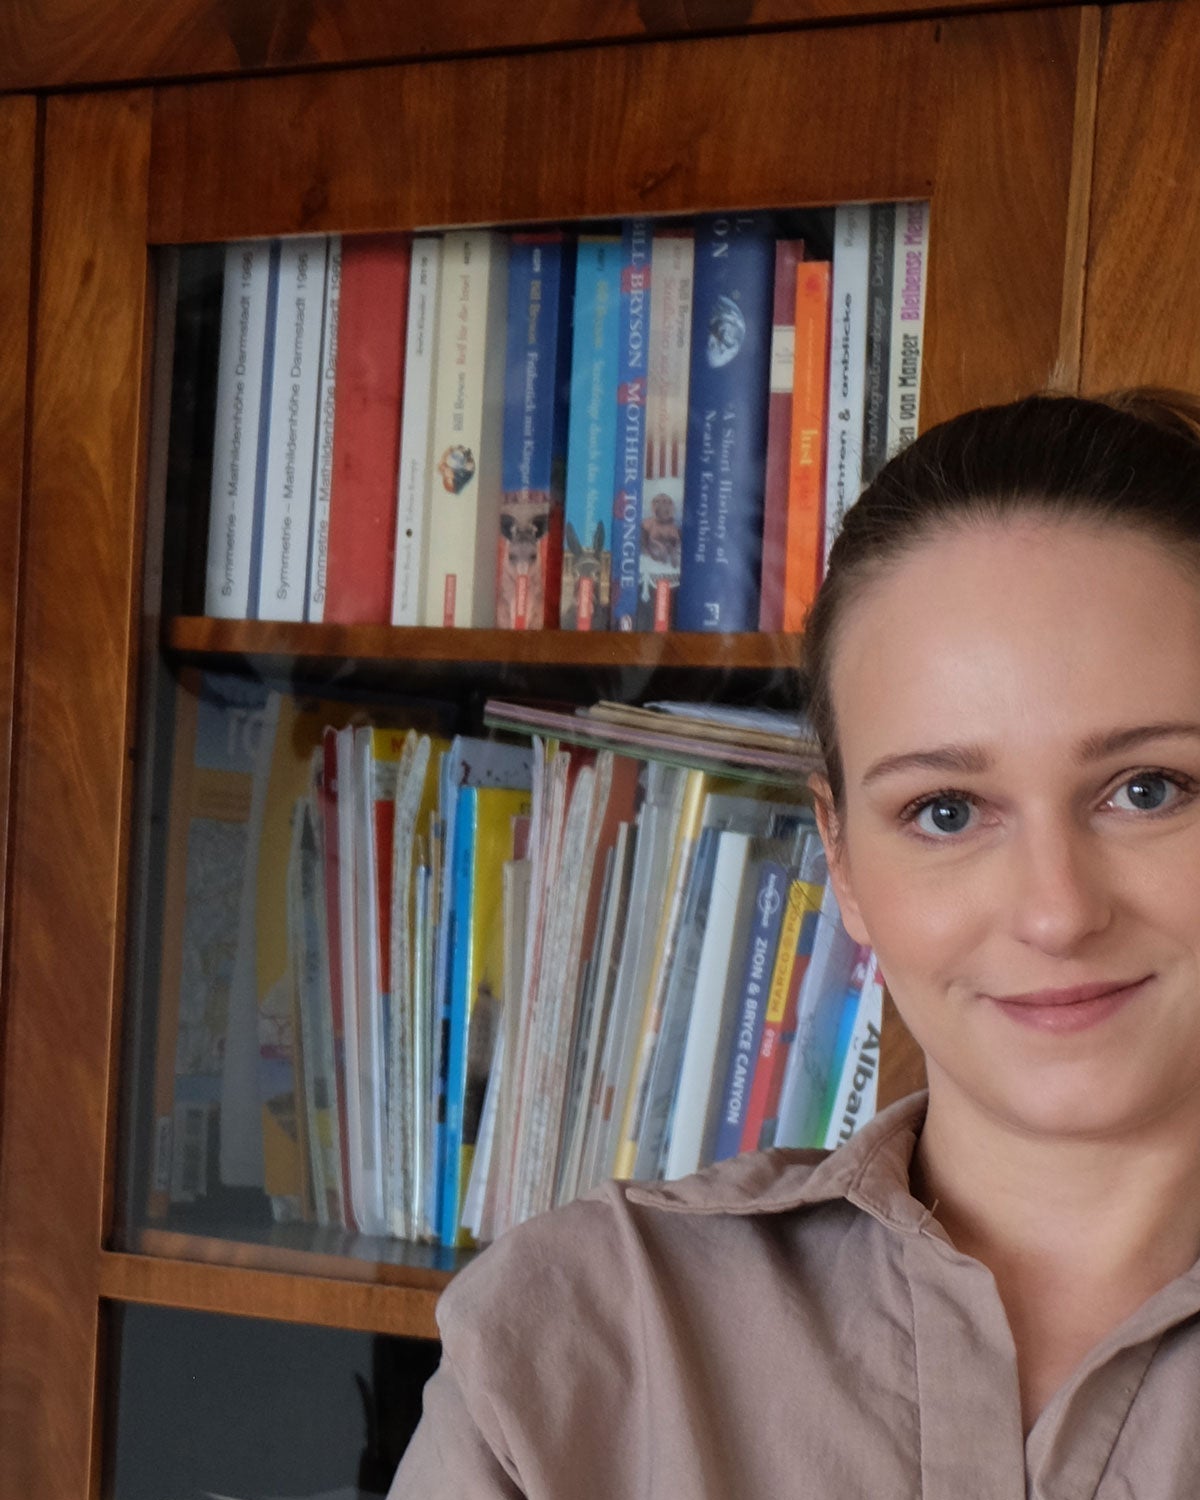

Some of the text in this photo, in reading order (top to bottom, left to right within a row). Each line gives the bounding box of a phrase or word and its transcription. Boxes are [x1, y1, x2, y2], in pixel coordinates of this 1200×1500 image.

[235, 295, 250, 375] Darmstadt
[290, 297, 305, 377] Darmstadt
[628, 272, 646, 367] BRYSON
[836, 293, 853, 423] & anblicke
[898, 332, 920, 388] Manger
[227, 380, 244, 496] Mathildenhöhe
[282, 383, 299, 499] Mathildenhöhe
[624, 382, 641, 483] MOTHER
[720, 426, 733, 472] Short
[899, 392, 916, 420] von
[313, 299, 340, 603] Symmetrie Mathildenhöhe Darmstadt
[695, 409, 715, 563] Nearly Everything
[221, 514, 236, 596] Symmetrie
[277, 516, 292, 599] Symmetrie
[620, 490, 637, 588] TONGUE
[713, 480, 730, 551] History
[770, 950, 790, 1012] MARCO
[726, 936, 768, 1124] ZION & BRYCE CANYON
